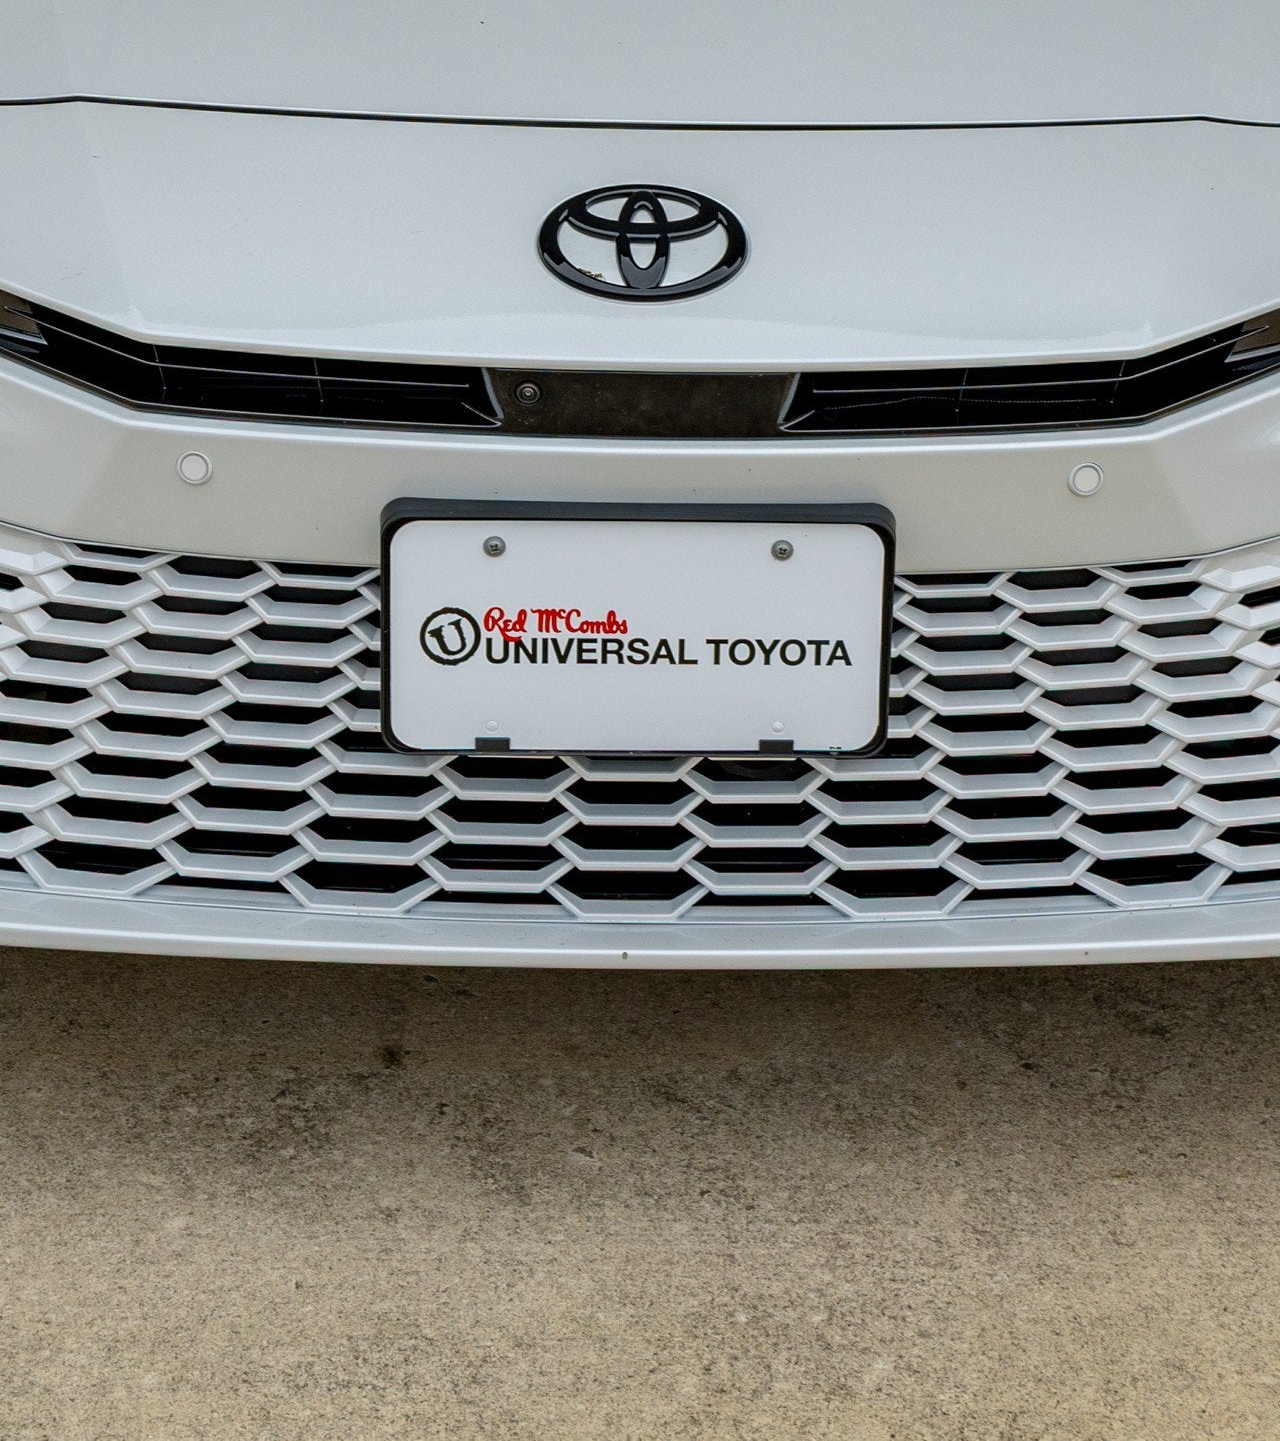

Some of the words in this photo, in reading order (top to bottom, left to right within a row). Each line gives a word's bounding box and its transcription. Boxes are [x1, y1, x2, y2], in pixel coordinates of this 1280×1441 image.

[483, 606, 529, 642] Red
[530, 608, 629, 635] McCombs
[485, 637, 698, 666] UNIVERSAL
[705, 638, 853, 667] TOYOTA
